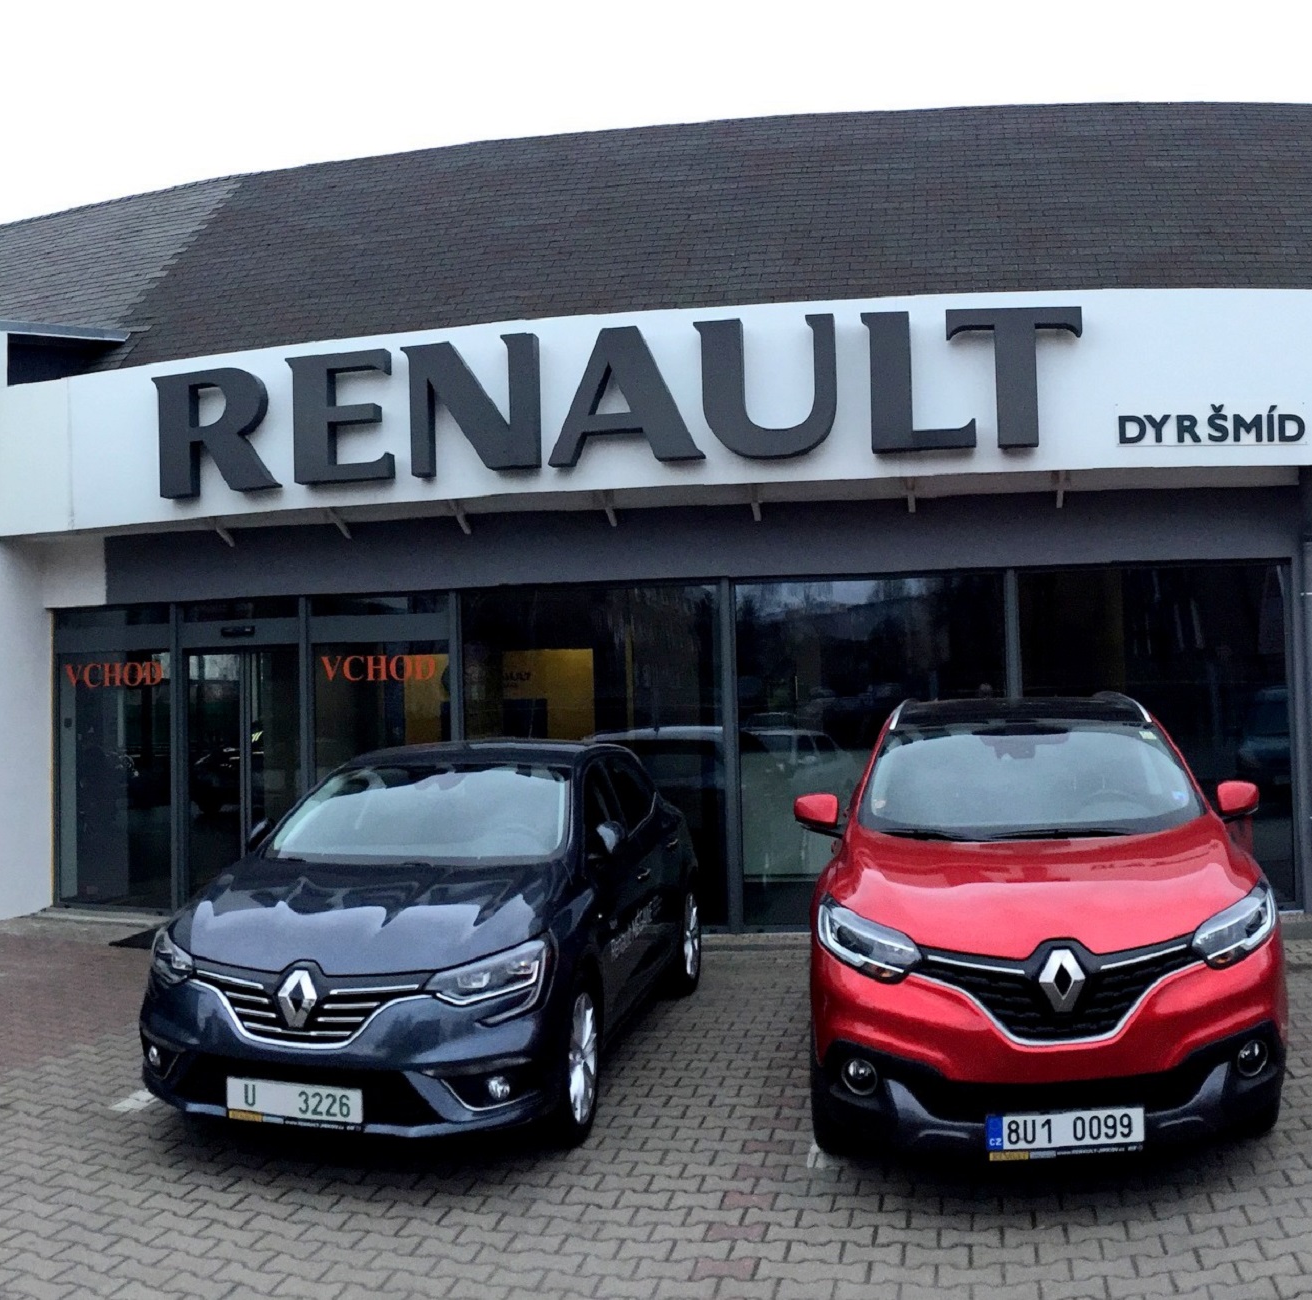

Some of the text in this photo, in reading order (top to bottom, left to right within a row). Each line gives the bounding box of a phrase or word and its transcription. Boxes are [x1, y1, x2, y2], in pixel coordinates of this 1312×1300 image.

[150, 306, 1083, 499] RENAULT
[65, 660, 164, 688] VCHOD
[321, 654, 436, 682] VCHOD
[243, 1083, 351, 1118] U 3226
[989, 1137, 1002, 1147] CZ
[1007, 1113, 1133, 1145] 8U1 0099
